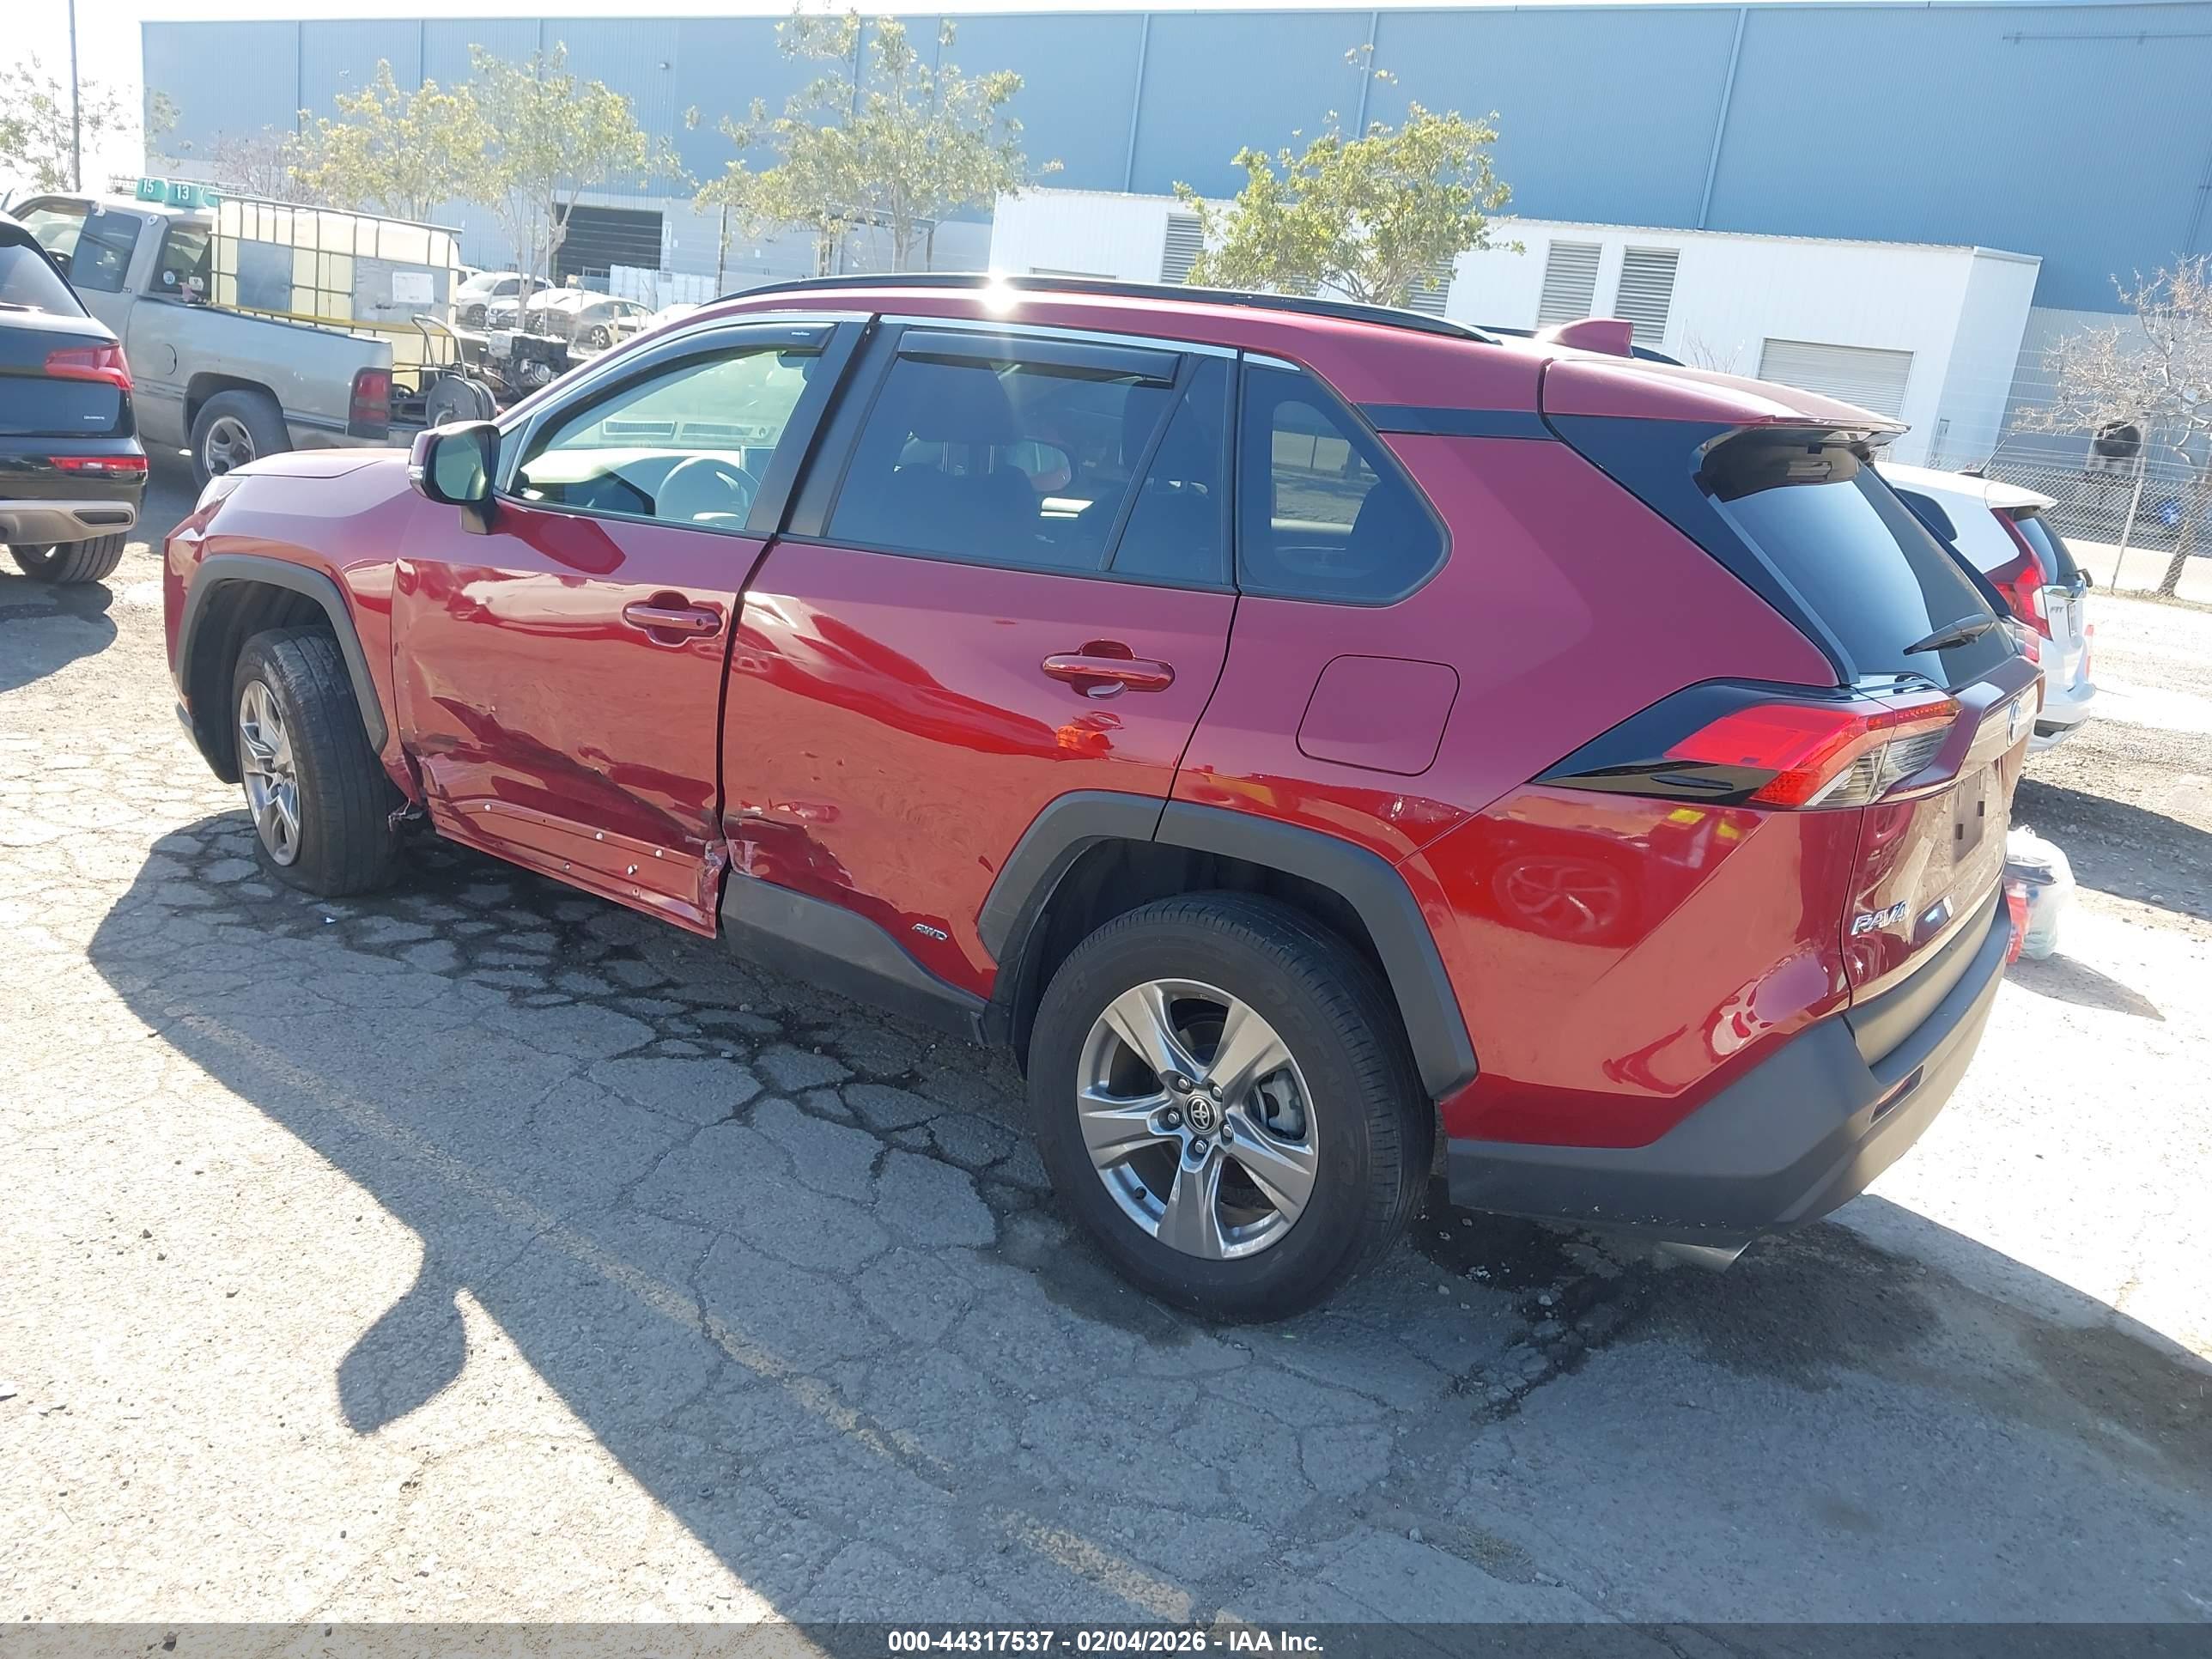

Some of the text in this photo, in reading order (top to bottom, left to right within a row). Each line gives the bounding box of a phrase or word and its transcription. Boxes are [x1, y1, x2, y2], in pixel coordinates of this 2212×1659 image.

[143, 178, 155, 193] 15
[176, 185, 190, 200] 13
[1850, 900, 1909, 935] RAV4
[911, 923, 948, 940] AWD
